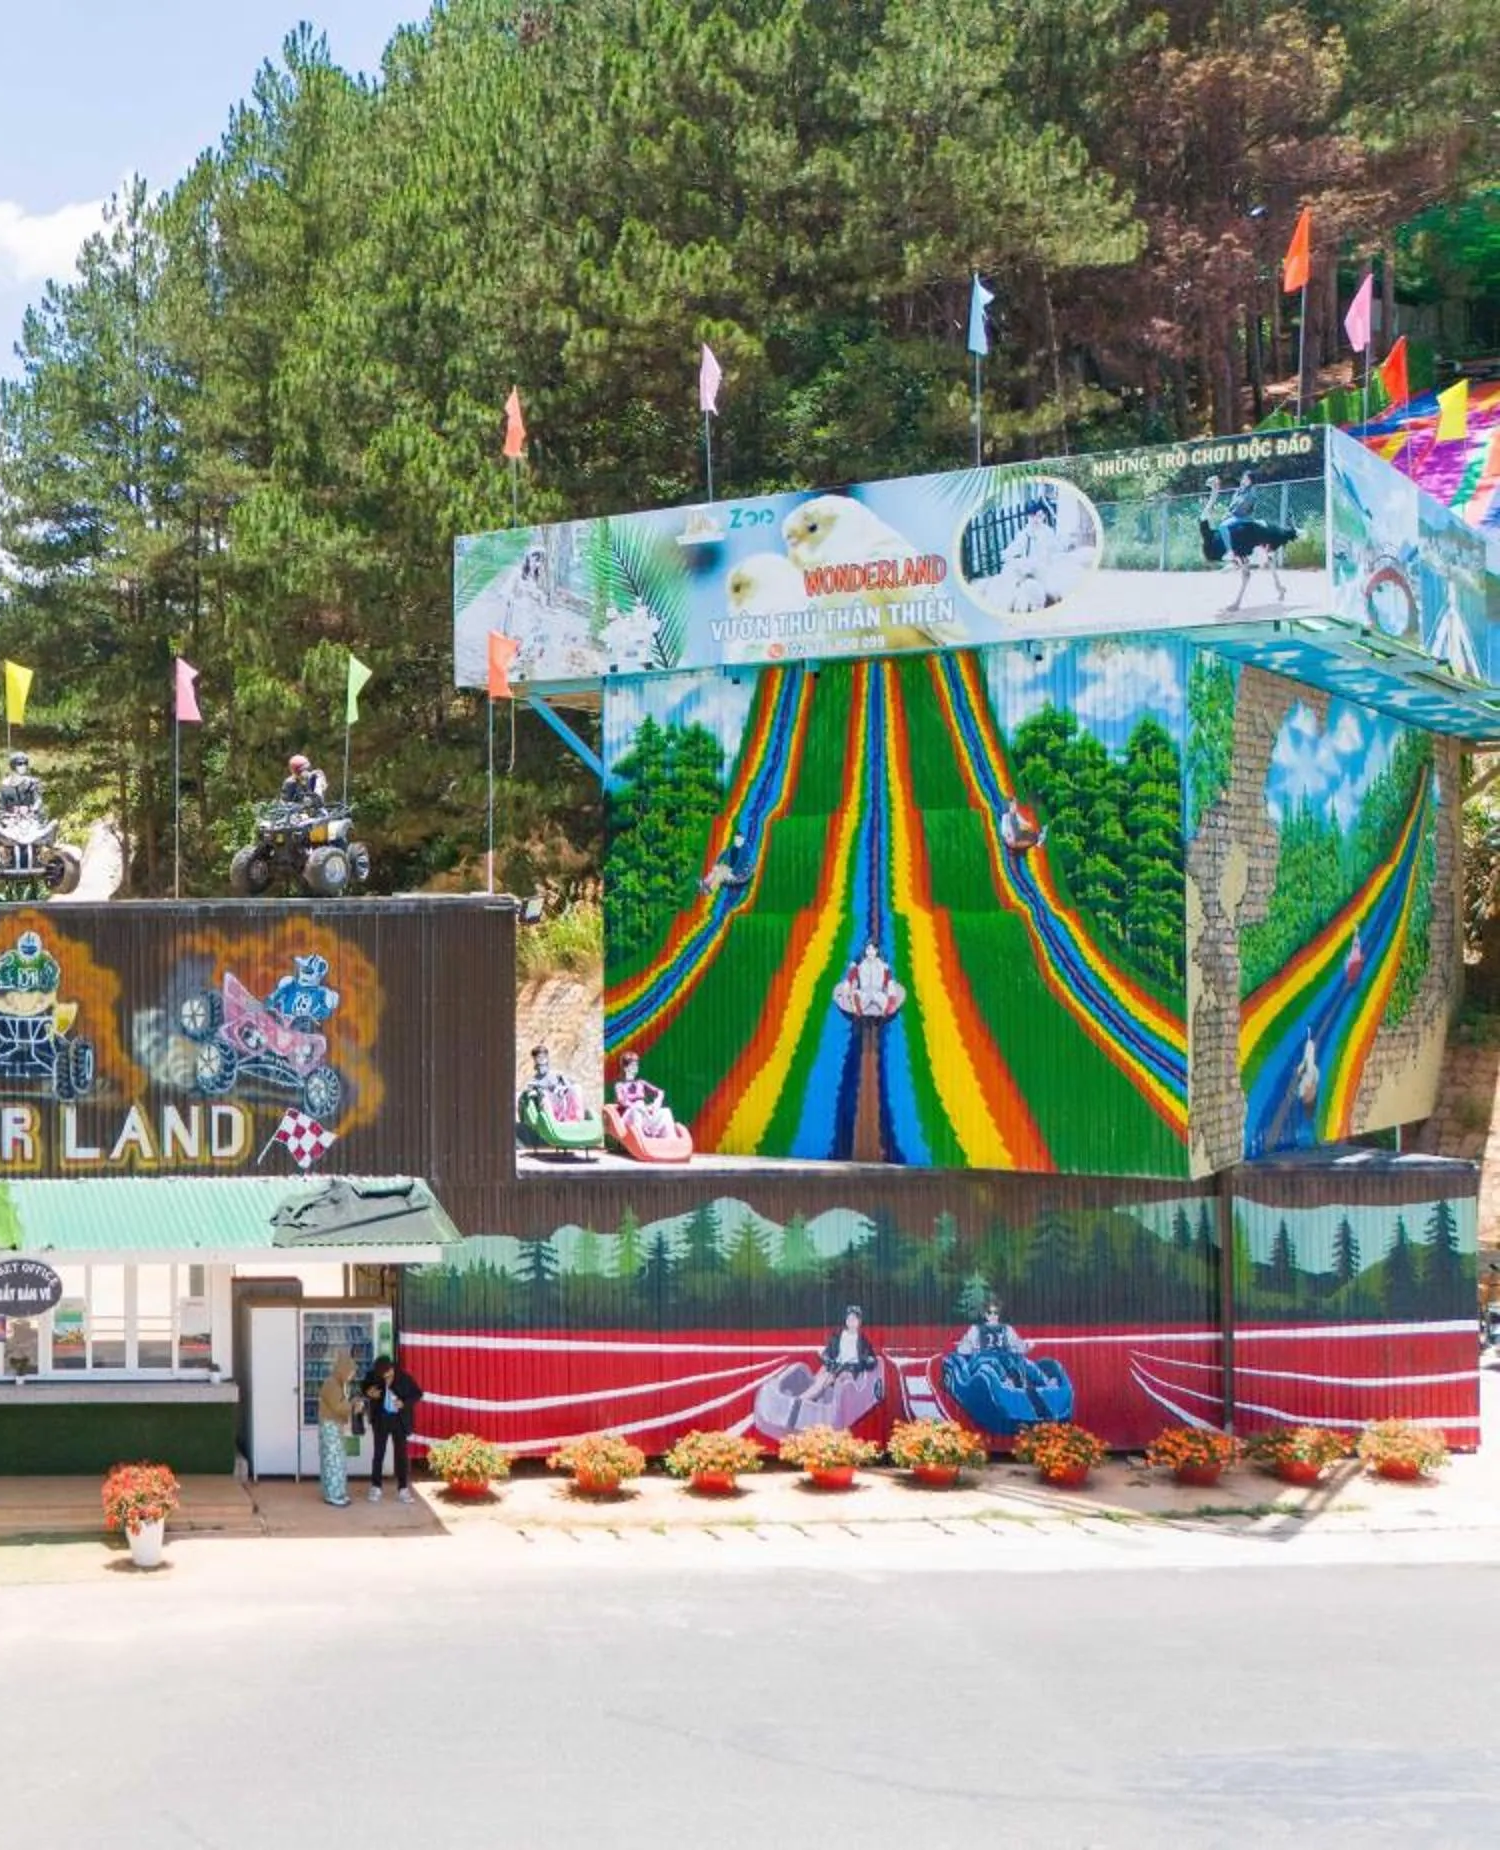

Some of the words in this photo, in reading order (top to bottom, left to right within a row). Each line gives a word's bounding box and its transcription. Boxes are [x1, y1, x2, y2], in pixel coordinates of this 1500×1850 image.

[1092, 453, 1151, 477] NHỮNG
[1156, 447, 1187, 469] TRÒ
[1191, 446, 1234, 466] CHƠI
[1276, 431, 1312, 456] ĐÁO
[804, 553, 947, 597] WONDERLAND
[826, 599, 880, 632] THÂN
